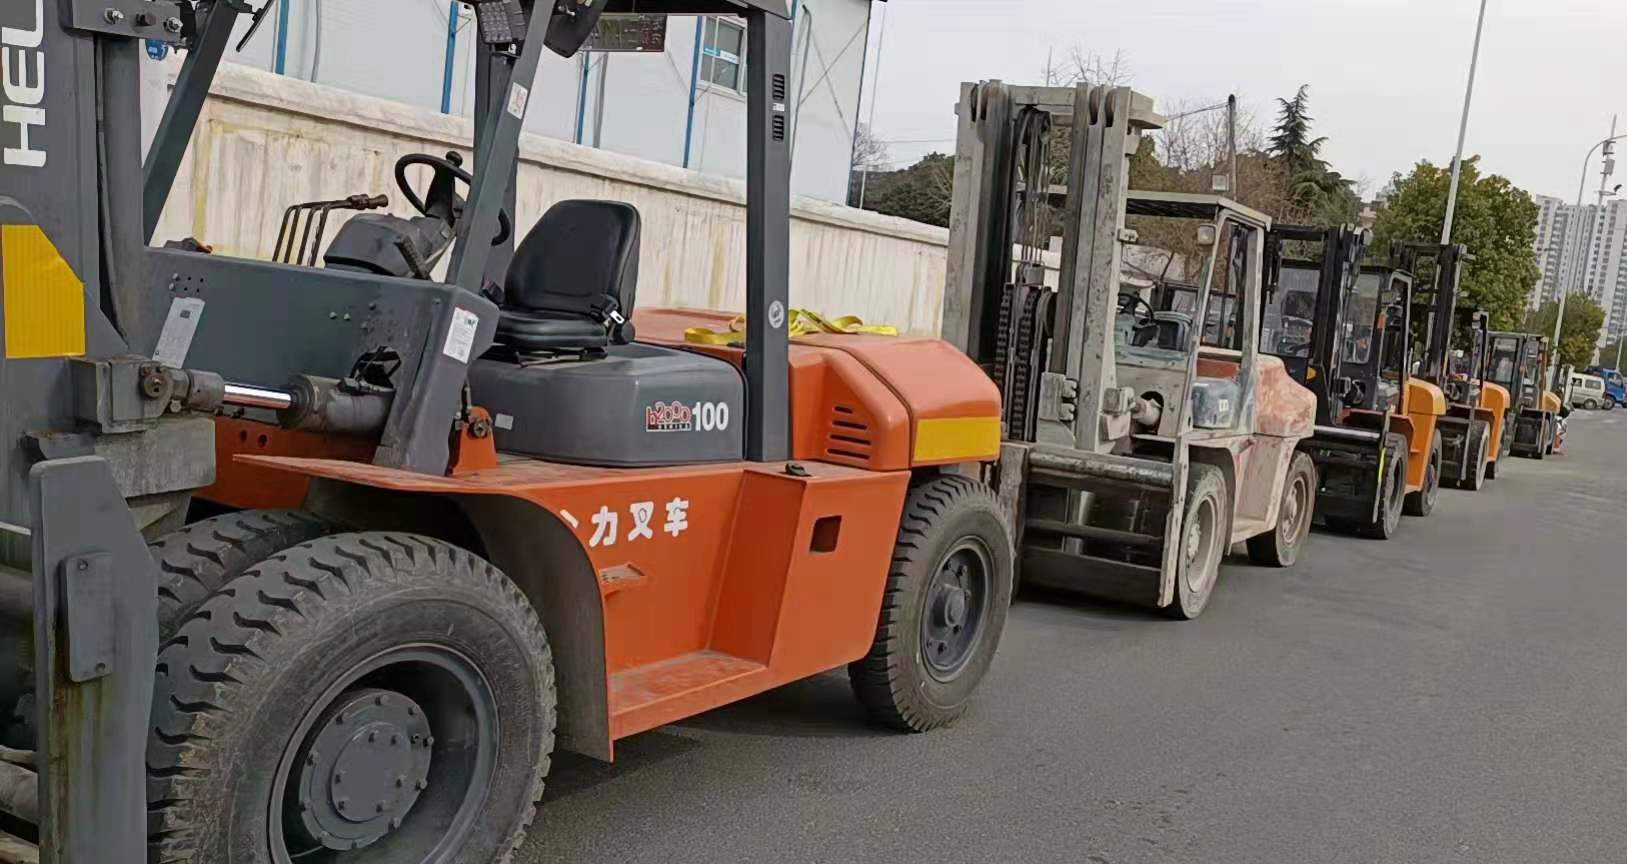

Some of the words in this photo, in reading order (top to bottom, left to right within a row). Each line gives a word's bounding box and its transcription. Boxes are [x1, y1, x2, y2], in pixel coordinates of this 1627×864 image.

[692, 402, 729, 431] 100
[560, 497, 689, 548] 力叉车
